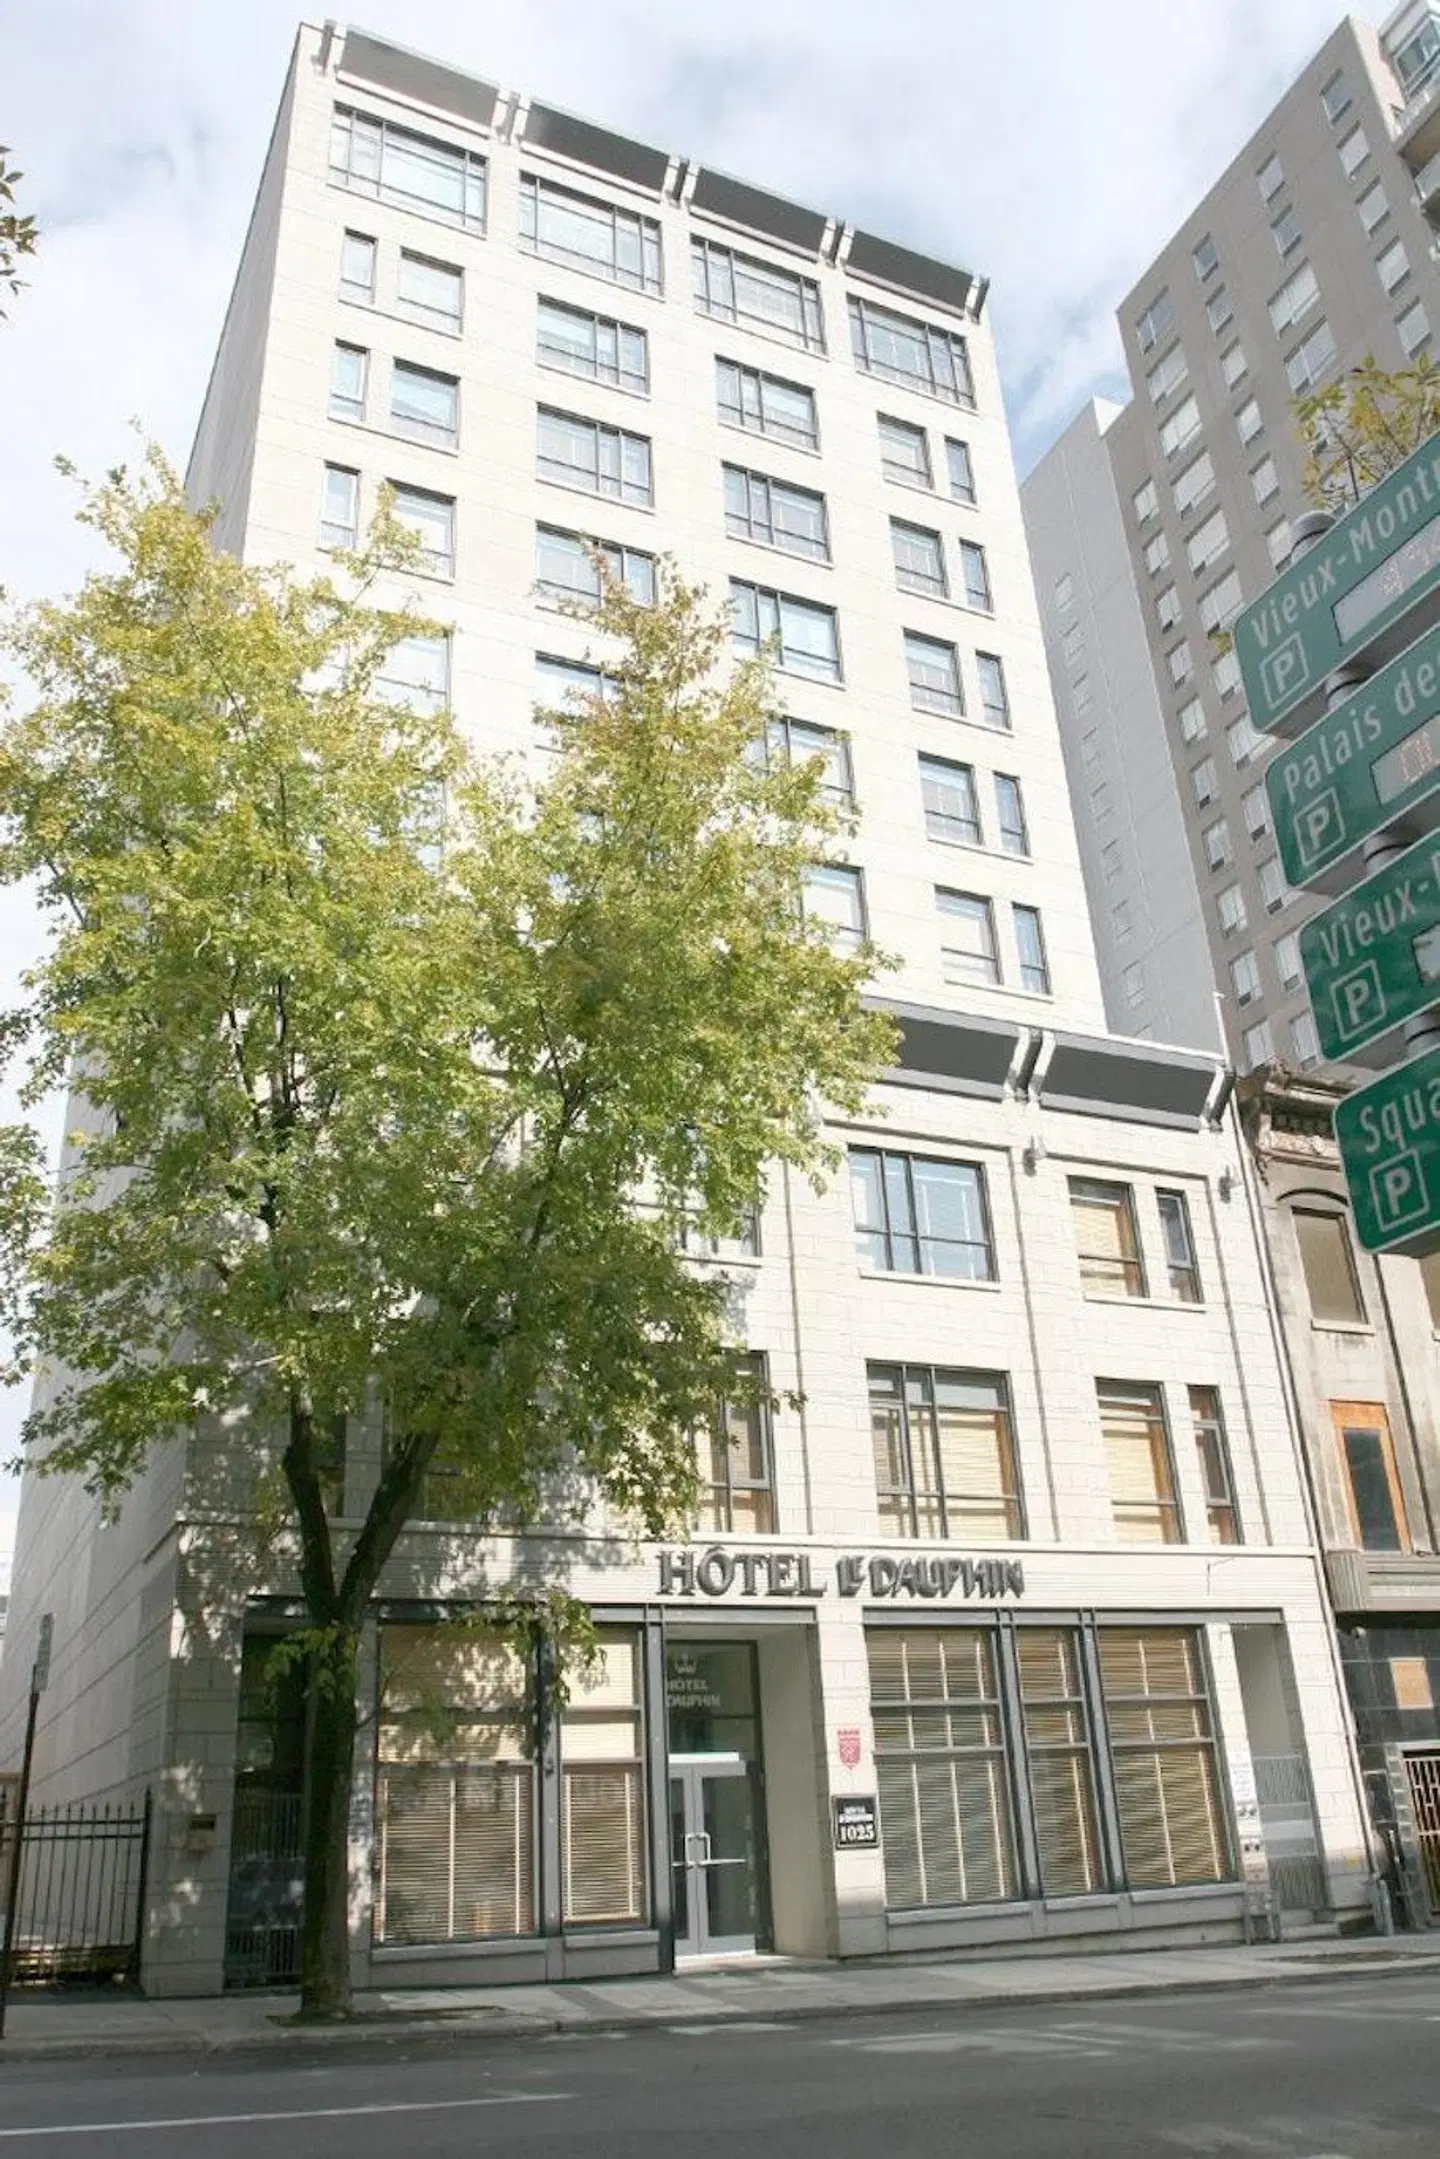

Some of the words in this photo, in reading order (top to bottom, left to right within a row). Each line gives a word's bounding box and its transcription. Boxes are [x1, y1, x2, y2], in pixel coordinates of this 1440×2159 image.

[1272, 650, 1294, 694] P
[1284, 706, 1382, 804] Palais
[1307, 806, 1330, 850] P
[1344, 978, 1369, 1025] P
[1384, 1166, 1411, 1217] P
[655, 1546, 828, 1597] HÔTEL
[868, 1555, 1025, 1599] DAUPHIN
